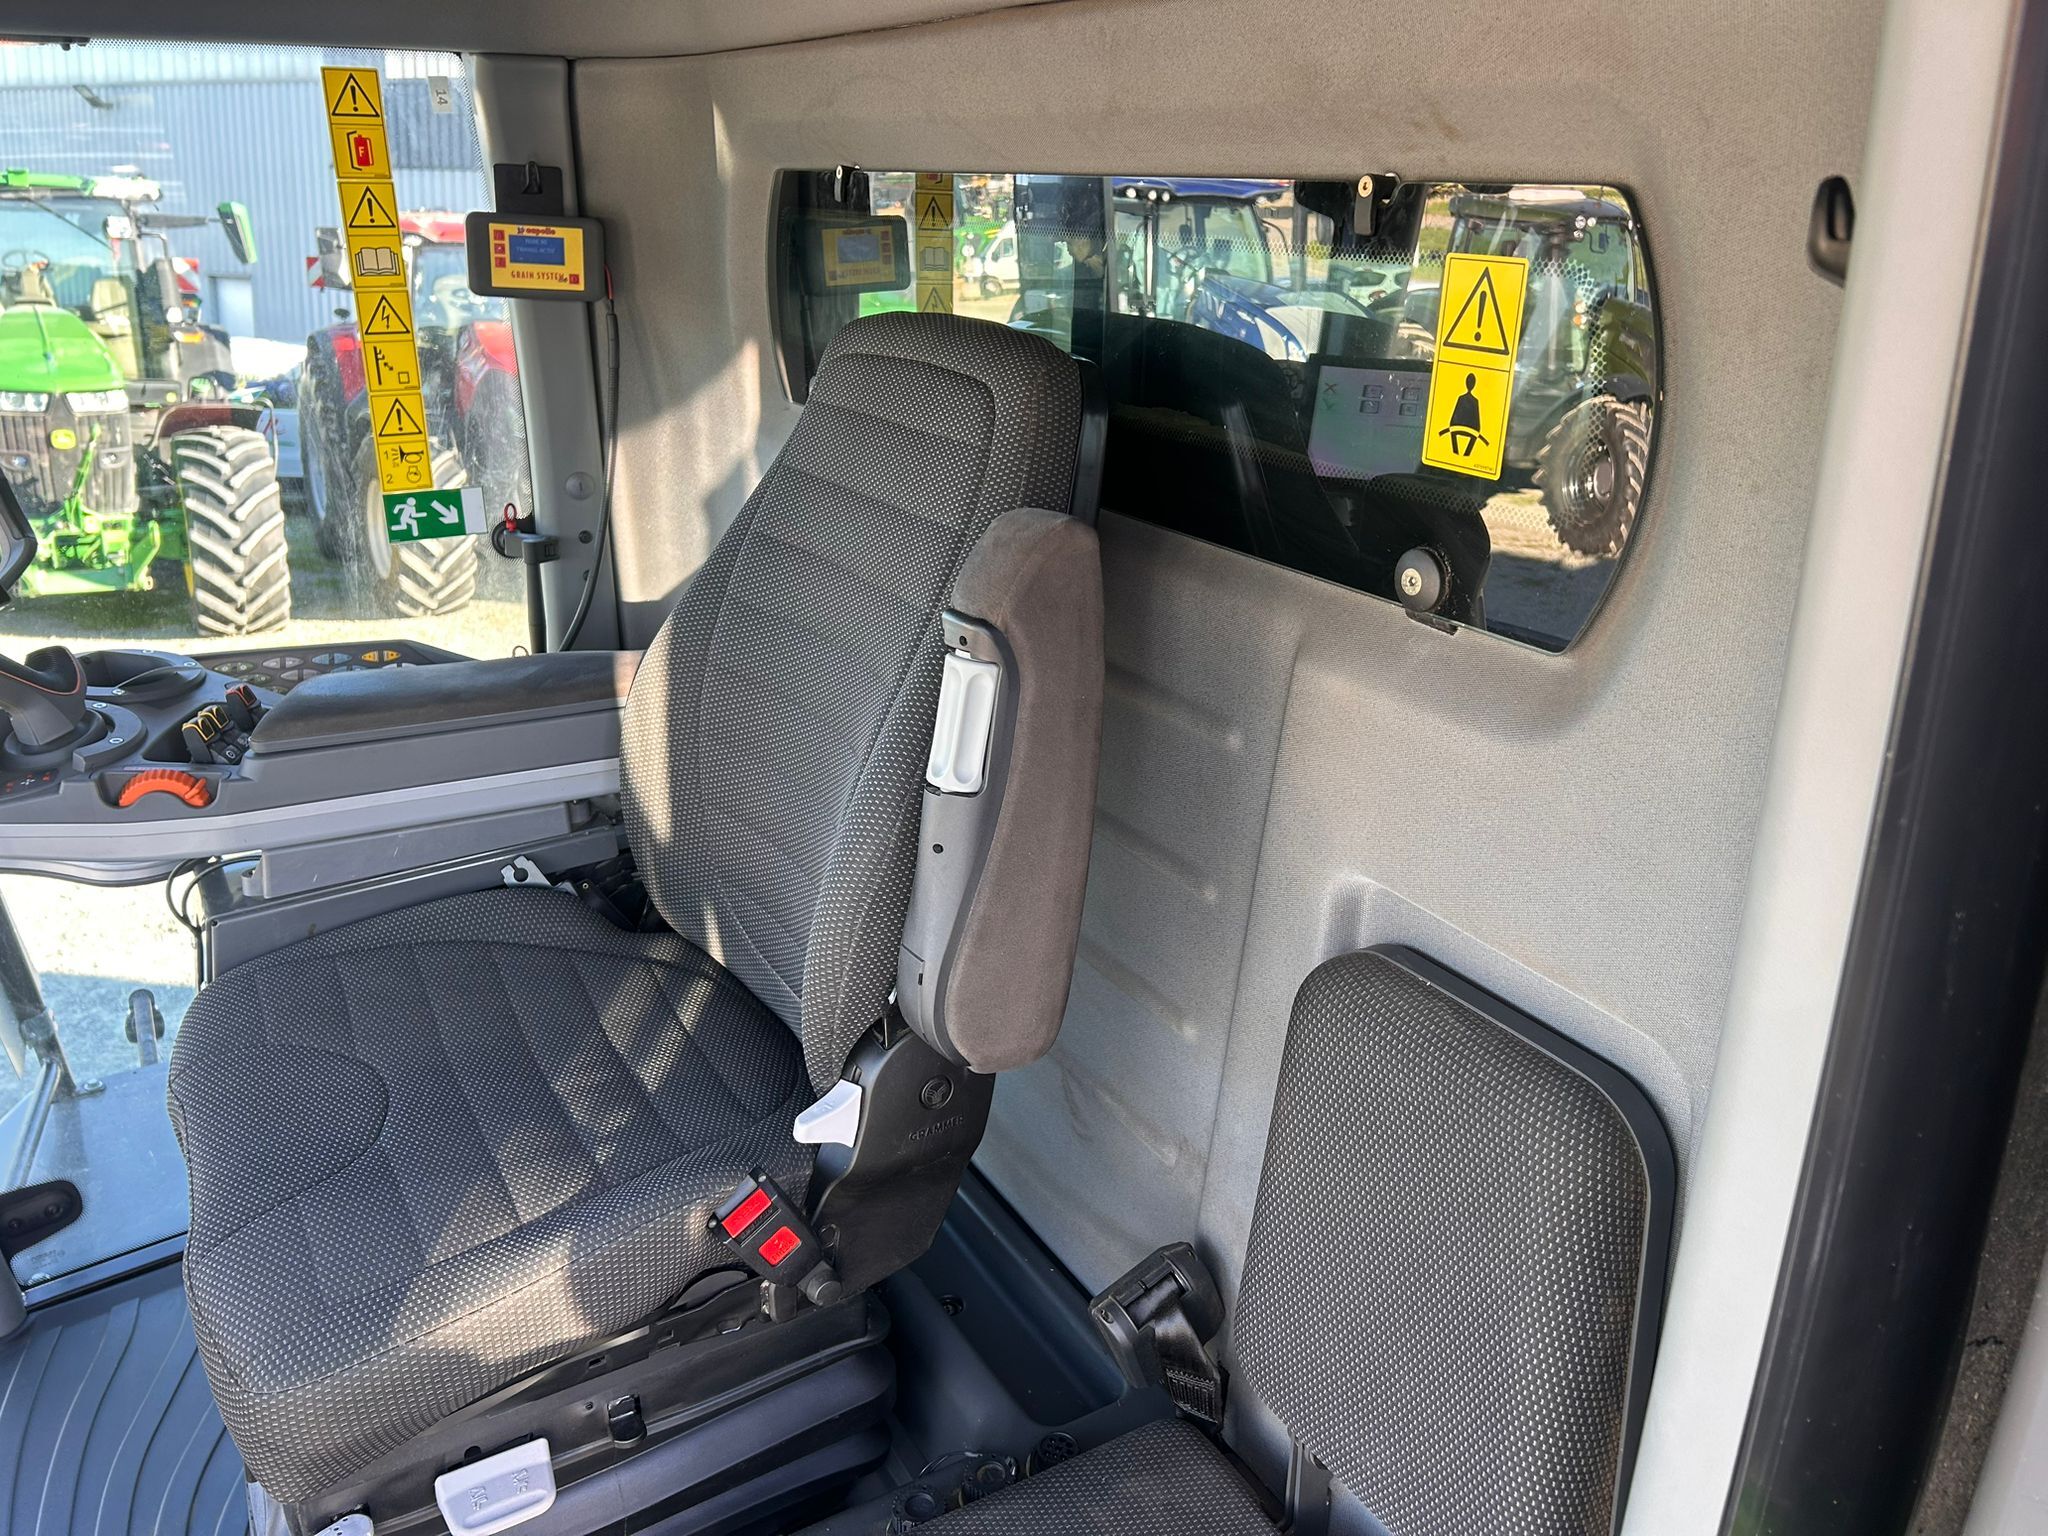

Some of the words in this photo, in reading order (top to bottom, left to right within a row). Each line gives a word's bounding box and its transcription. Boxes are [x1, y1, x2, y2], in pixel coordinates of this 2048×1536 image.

[435, 89, 448, 106] 14
[358, 146, 366, 158] F
[511, 271, 535, 280] GRAIN
[536, 272, 565, 281] SYSTEM
[386, 473, 394, 484] 2
[908, 1114, 965, 1142] GRAMMER
